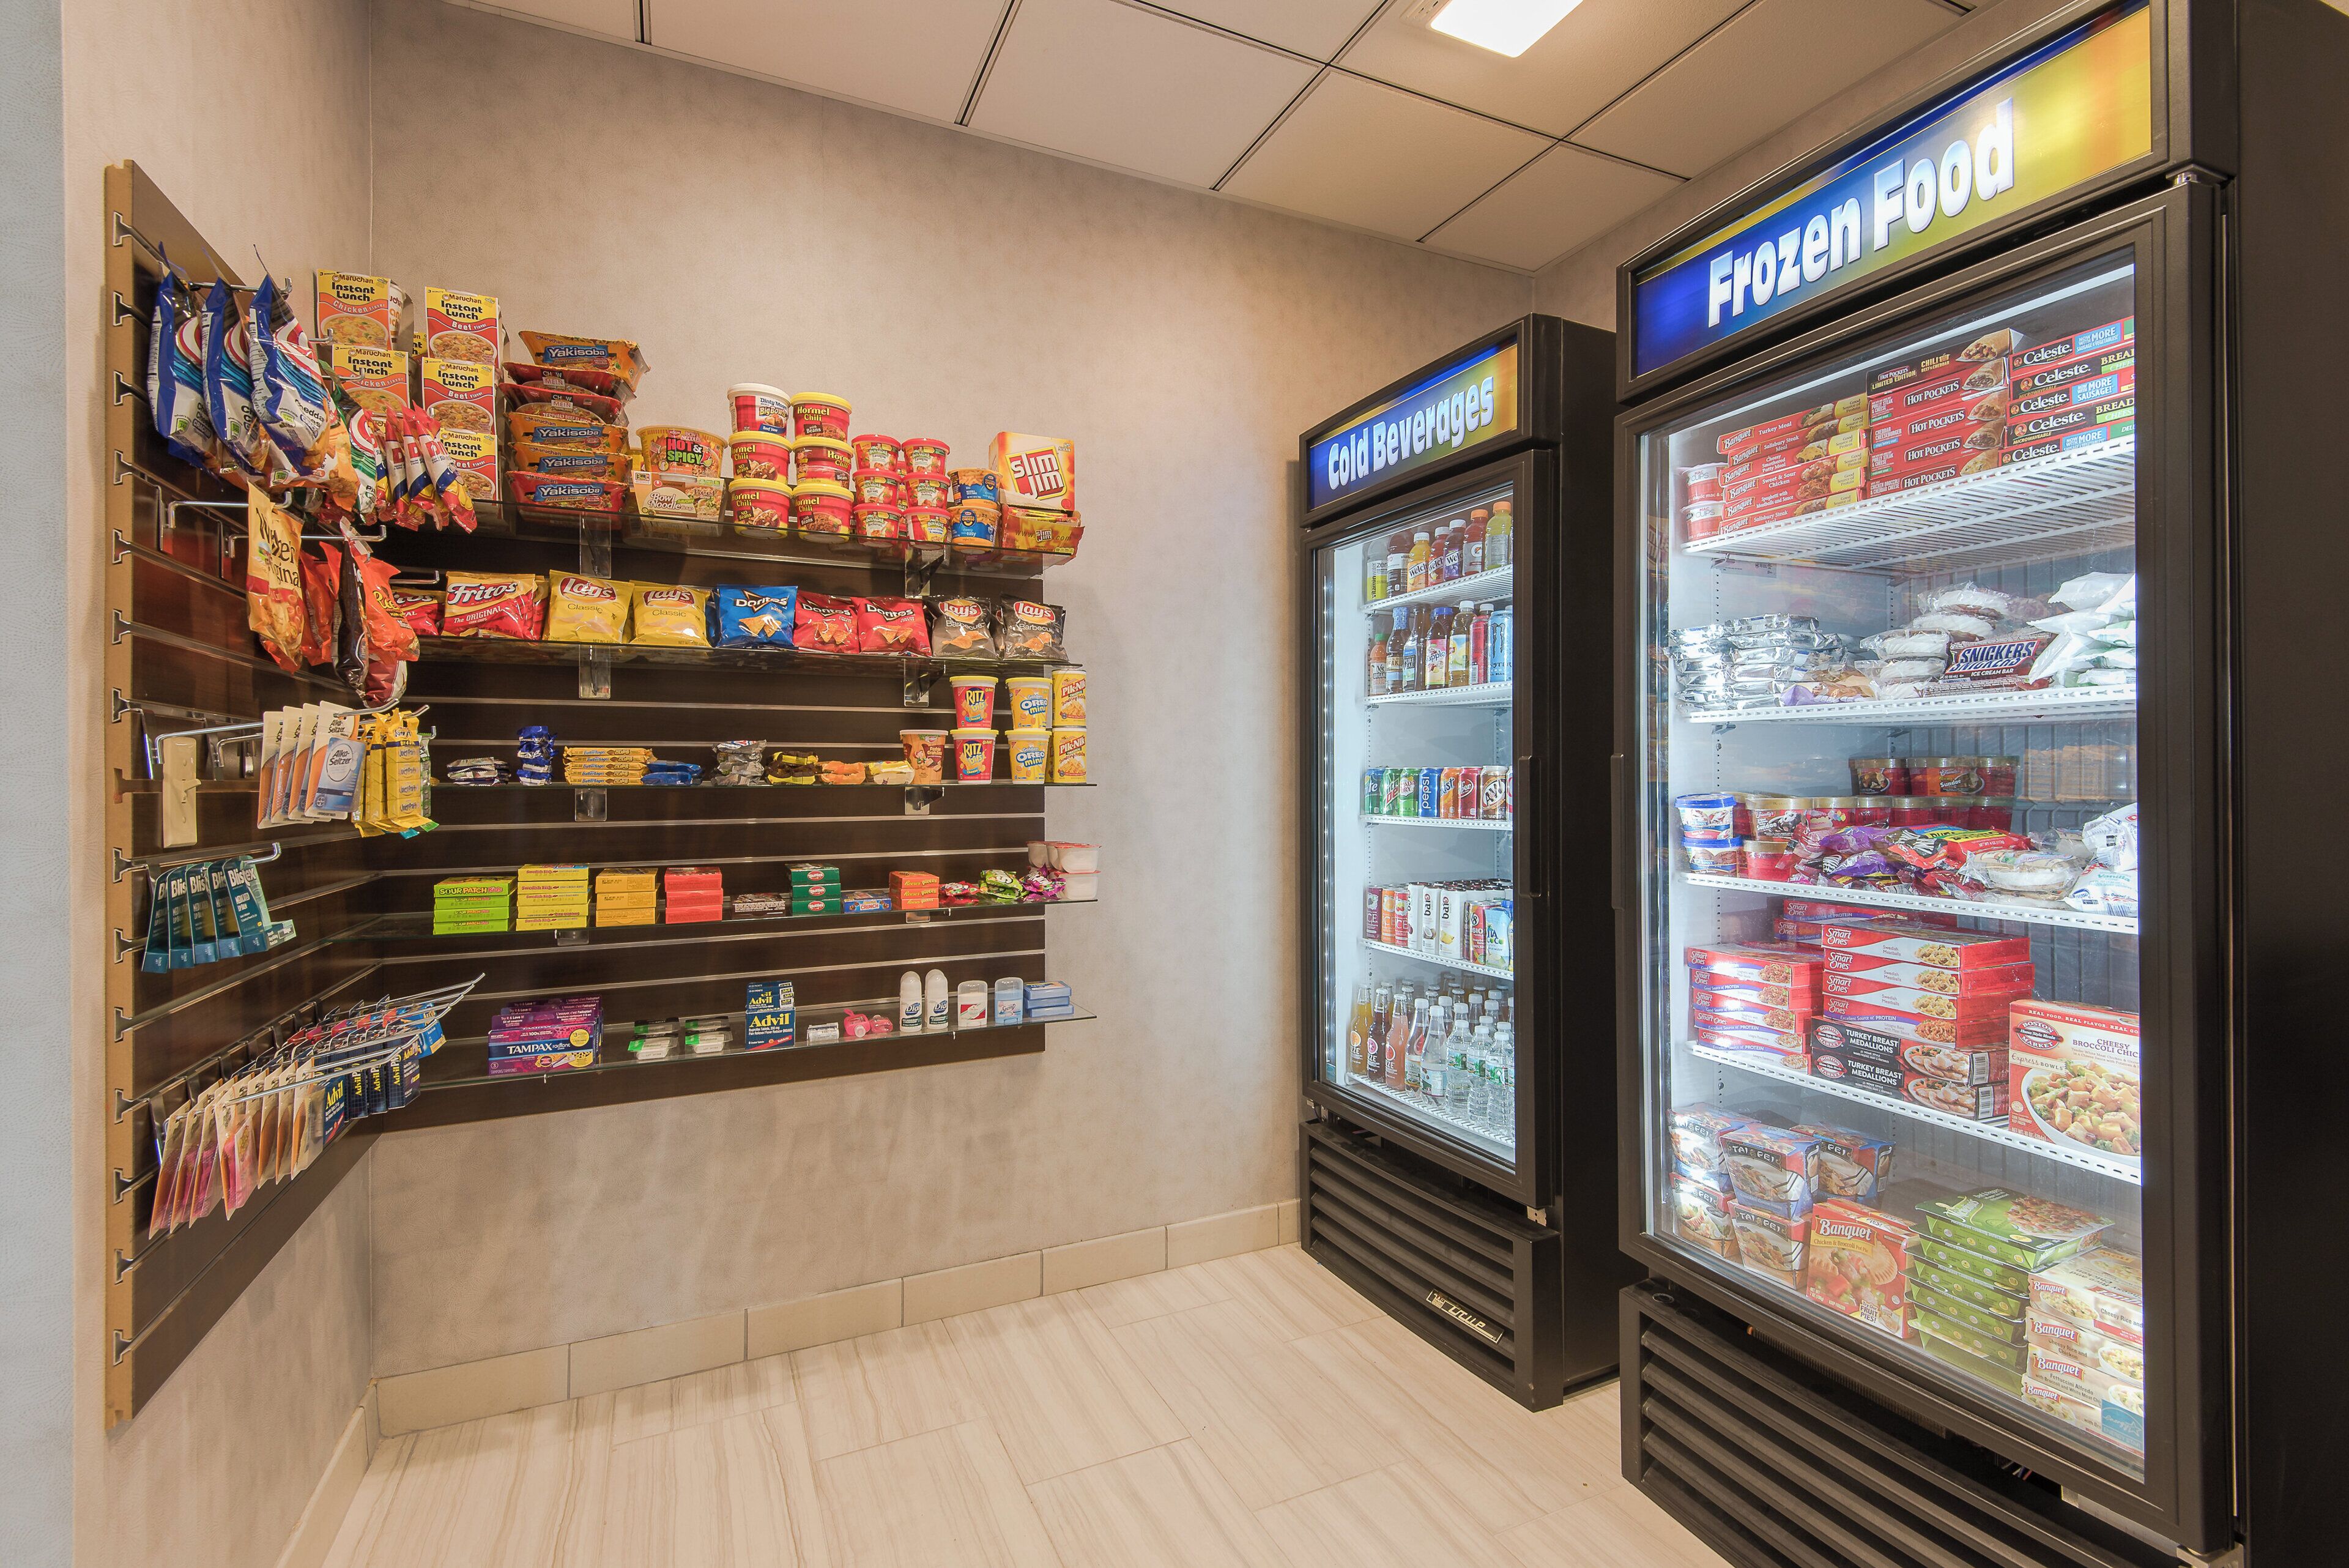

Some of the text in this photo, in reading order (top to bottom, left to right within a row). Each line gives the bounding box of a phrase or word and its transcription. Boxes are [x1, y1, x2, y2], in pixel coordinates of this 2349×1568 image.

[1708, 97, 2014, 328] Frozen Food
[339, 274, 374, 284] Maruchan
[332, 281, 375, 294] Instant
[336, 291, 370, 302] Lunch
[449, 294, 481, 303] Maruchan
[333, 300, 367, 313] Chicken
[440, 300, 483, 313] Instant
[446, 308, 478, 320] Lunch
[451, 321, 472, 330] Beef
[2091, 327, 2116, 341] MORE
[356, 349, 390, 358] Maruchan
[549, 347, 606, 358] Yakisoba
[348, 356, 393, 368] Instant
[446, 363, 478, 373] Maruchan
[438, 370, 479, 382] Instant
[442, 378, 475, 388] Lunch
[2088, 377, 2112, 390] MORE
[1907, 381, 1959, 405] HOT POCKETS
[760, 398, 775, 406] Dinty
[797, 406, 831, 416] Hormel
[529, 417, 556, 426] Maruchan
[804, 413, 822, 422] Chili
[1910, 411, 1965, 434] HOT POCKETS
[448, 433, 481, 442] Maruchan
[1328, 376, 1494, 489] Cold Beverages
[1723, 422, 1792, 450] Banquet Turkey Meal
[667, 438, 703, 453] HOT &
[1764, 435, 1800, 450] Salisbury Steak
[534, 447, 561, 456] Maruchan
[1732, 445, 1759, 465] Banquet
[1908, 439, 1961, 461] HOT POCKETS
[544, 458, 604, 467] Yakisoba
[667, 450, 703, 464] SPICY
[1724, 463, 1751, 483] Banquet
[1904, 467, 1956, 488] HOT POCKETS
[1762, 476, 1777, 485] Sweet
[1768, 479, 1790, 488] Chicken
[540, 487, 600, 496] Yakisoba
[1729, 480, 1757, 499] Banquet
[650, 492, 676, 502] Bowl
[648, 499, 681, 510] Noodle
[1727, 497, 1753, 516] Banquet
[447, 581, 518, 605] Fritos
[568, 603, 603, 614] Classic
[735, 597, 789, 608] Doritos
[466, 605, 504, 622] ORIGINAL
[802, 603, 852, 615] Doritos
[867, 604, 914, 620] Doritos
[1020, 623, 1054, 634] Barbecue
[1959, 641, 2035, 664] SNICKERS
[966, 689, 985, 704] RITZ
[1021, 699, 1048, 709] OREO
[332, 749, 350, 758] Alka-
[963, 743, 982, 757] RITZ
[328, 757, 352, 765] Seltzer
[1017, 752, 1045, 762] OREO
[1025, 759, 1042, 767] mini
[1421, 776, 1430, 809] pepsi
[228, 868, 257, 887] Blistex
[1825, 927, 1852, 939] Smart
[1827, 936, 1848, 945] Ones
[1690, 951, 1707, 960] Smart
[1691, 957, 1705, 965] Ones
[1828, 952, 1853, 964] Smart
[1829, 960, 1850, 970] Ones
[1826, 975, 1852, 987] Smart
[1828, 984, 1849, 994] Ones
[749, 996, 773, 1005] Advil
[1827, 998, 1850, 1009] Smart
[1829, 1006, 1846, 1015] Ones
[749, 1013, 790, 1028] Advil
[2022, 1020, 2054, 1033] BOSTON
[1846, 1028, 1899, 1047] TURKEY BREAST
[2021, 1035, 2054, 1049] MARKET
[2097, 1038, 2131, 1049] CHEESY
[507, 1042, 552, 1054] TAMPAX
[1849, 1038, 1894, 1053] MEDALLIONS
[2073, 1039, 2115, 1053] BROCCOLI
[2011, 1051, 2064, 1071] Express BOWLS
[1847, 1060, 1903, 1080] TURKEY BREAST
[1851, 1069, 1898, 1086] MEDALLIONS
[325, 1080, 344, 1110] Advil
[1819, 1219, 1872, 1241] Banquet
[2033, 1281, 2066, 1295] Banquet
[1860, 1306, 1879, 1318] FRUIT
[1860, 1312, 1877, 1323] PIES!
[2101, 1308, 2132, 1324] Cheesy Rice
[2034, 1321, 2076, 1340] Banquet
[2037, 1357, 2080, 1377] Banquet
[2027, 1385, 2059, 1400] Banquet
